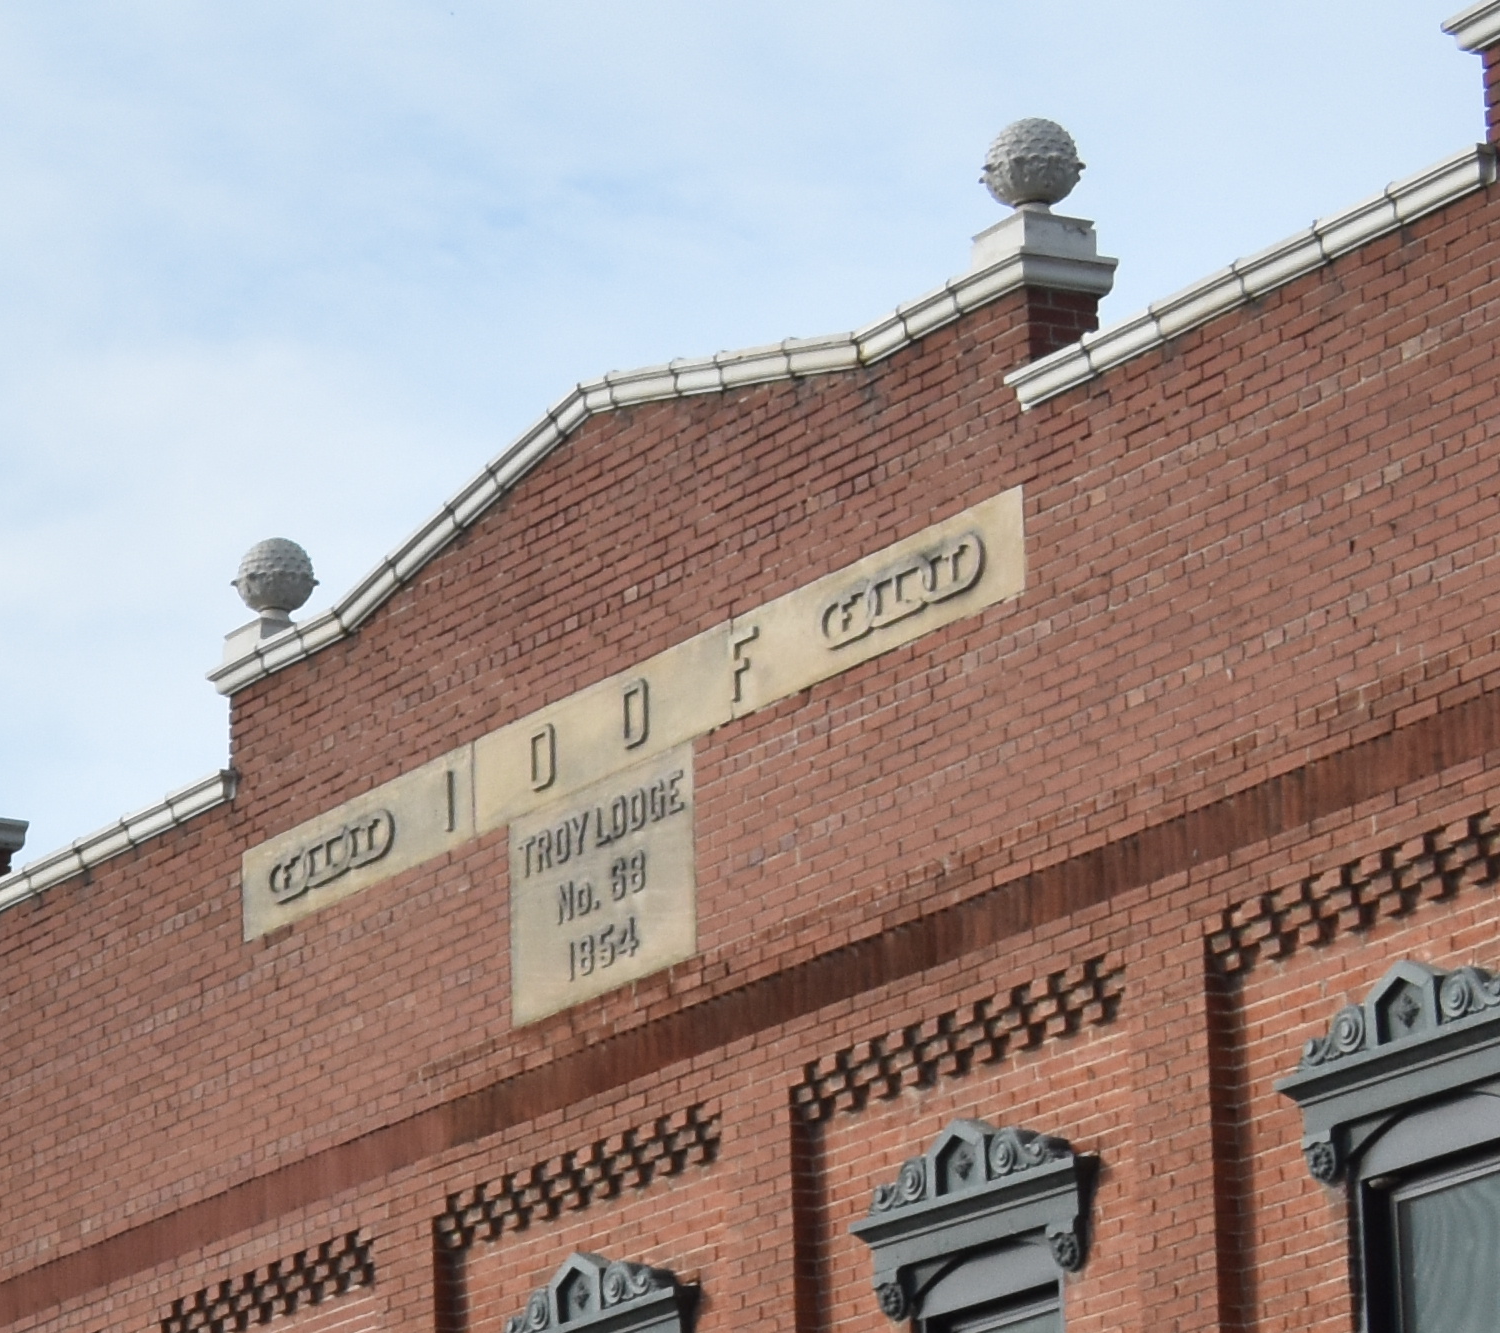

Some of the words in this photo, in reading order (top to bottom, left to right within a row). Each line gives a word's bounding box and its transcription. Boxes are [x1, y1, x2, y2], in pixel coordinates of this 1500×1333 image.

[518, 811, 590, 879] TROY
[595, 769, 686, 848] LODGE
[557, 880, 601, 926] No.
[611, 849, 647, 902] 68
[570, 916, 640, 983] 1854
